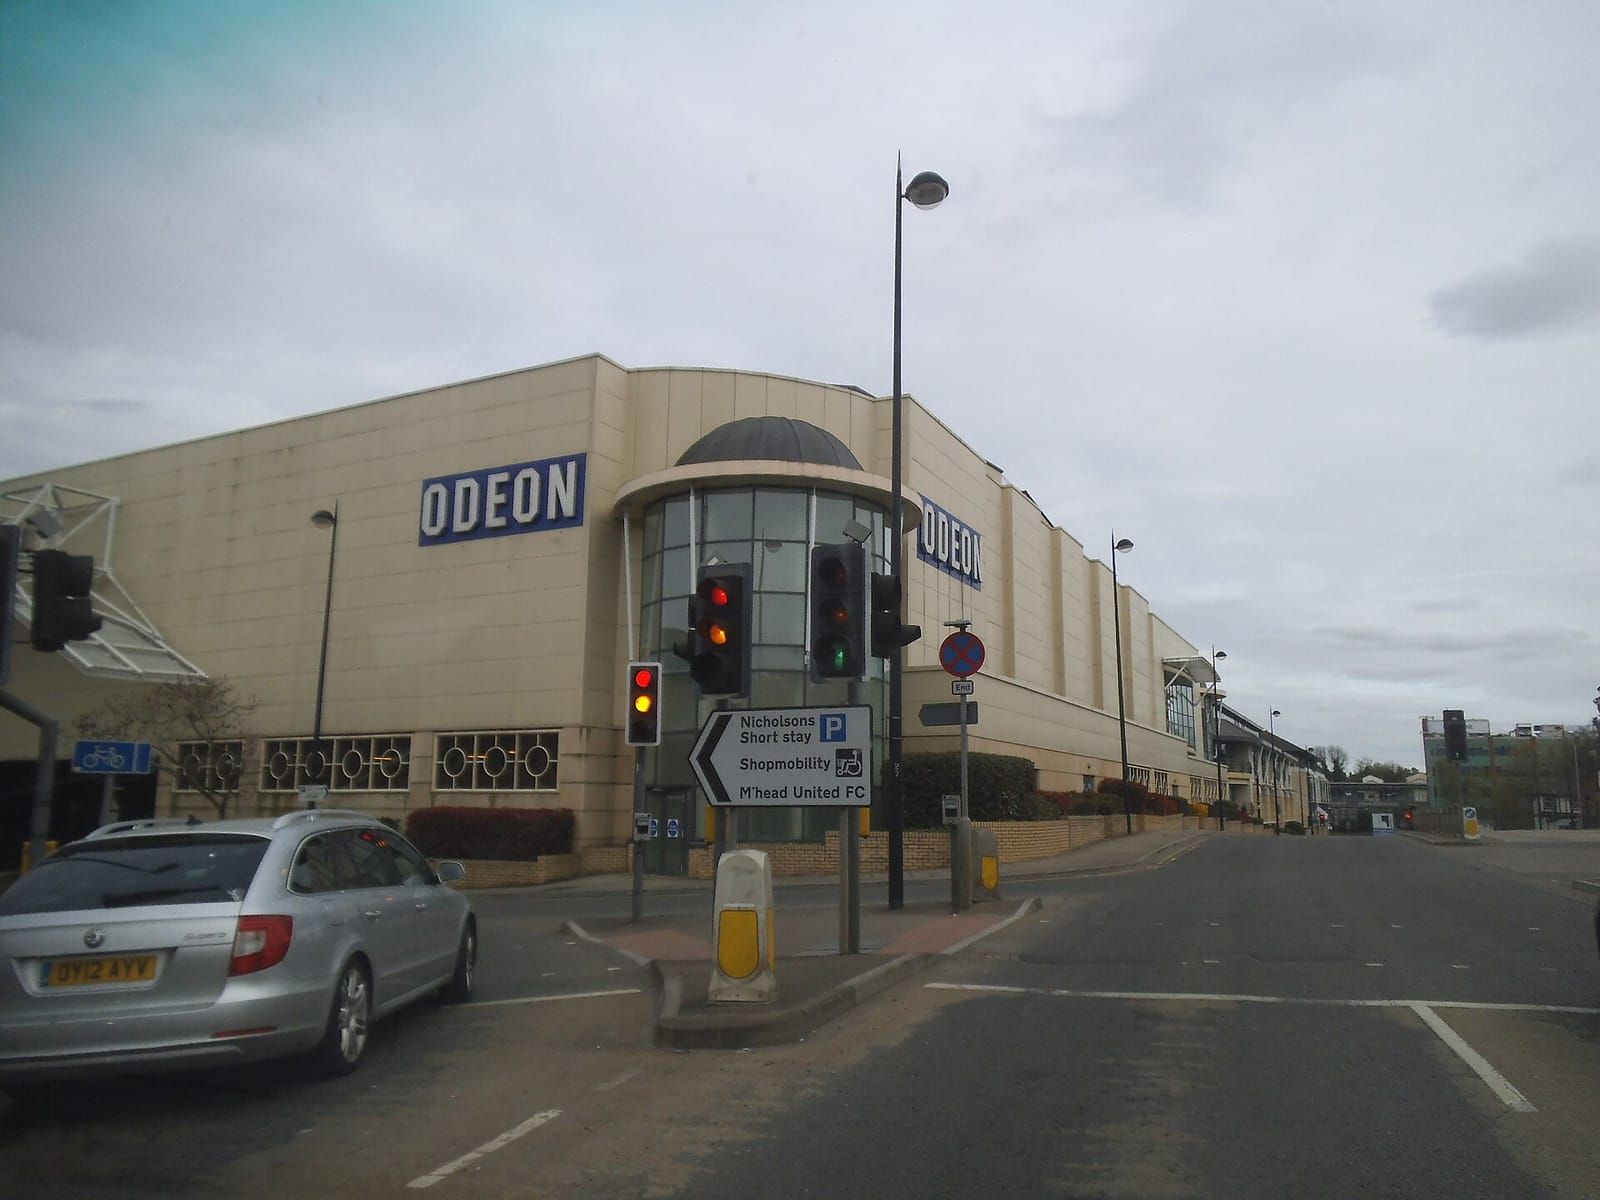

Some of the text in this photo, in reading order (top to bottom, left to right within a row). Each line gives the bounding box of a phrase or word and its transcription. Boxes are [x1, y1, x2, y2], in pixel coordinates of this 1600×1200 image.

[421, 461, 576, 536] ODEON
[922, 503, 982, 583] ODEON
[740, 716, 815, 728] Nicholsons
[826, 717, 841, 740] P
[740, 731, 811, 744] Short stay
[740, 757, 831, 772] Shopmobility
[740, 786, 865, 799] M'head United FC
